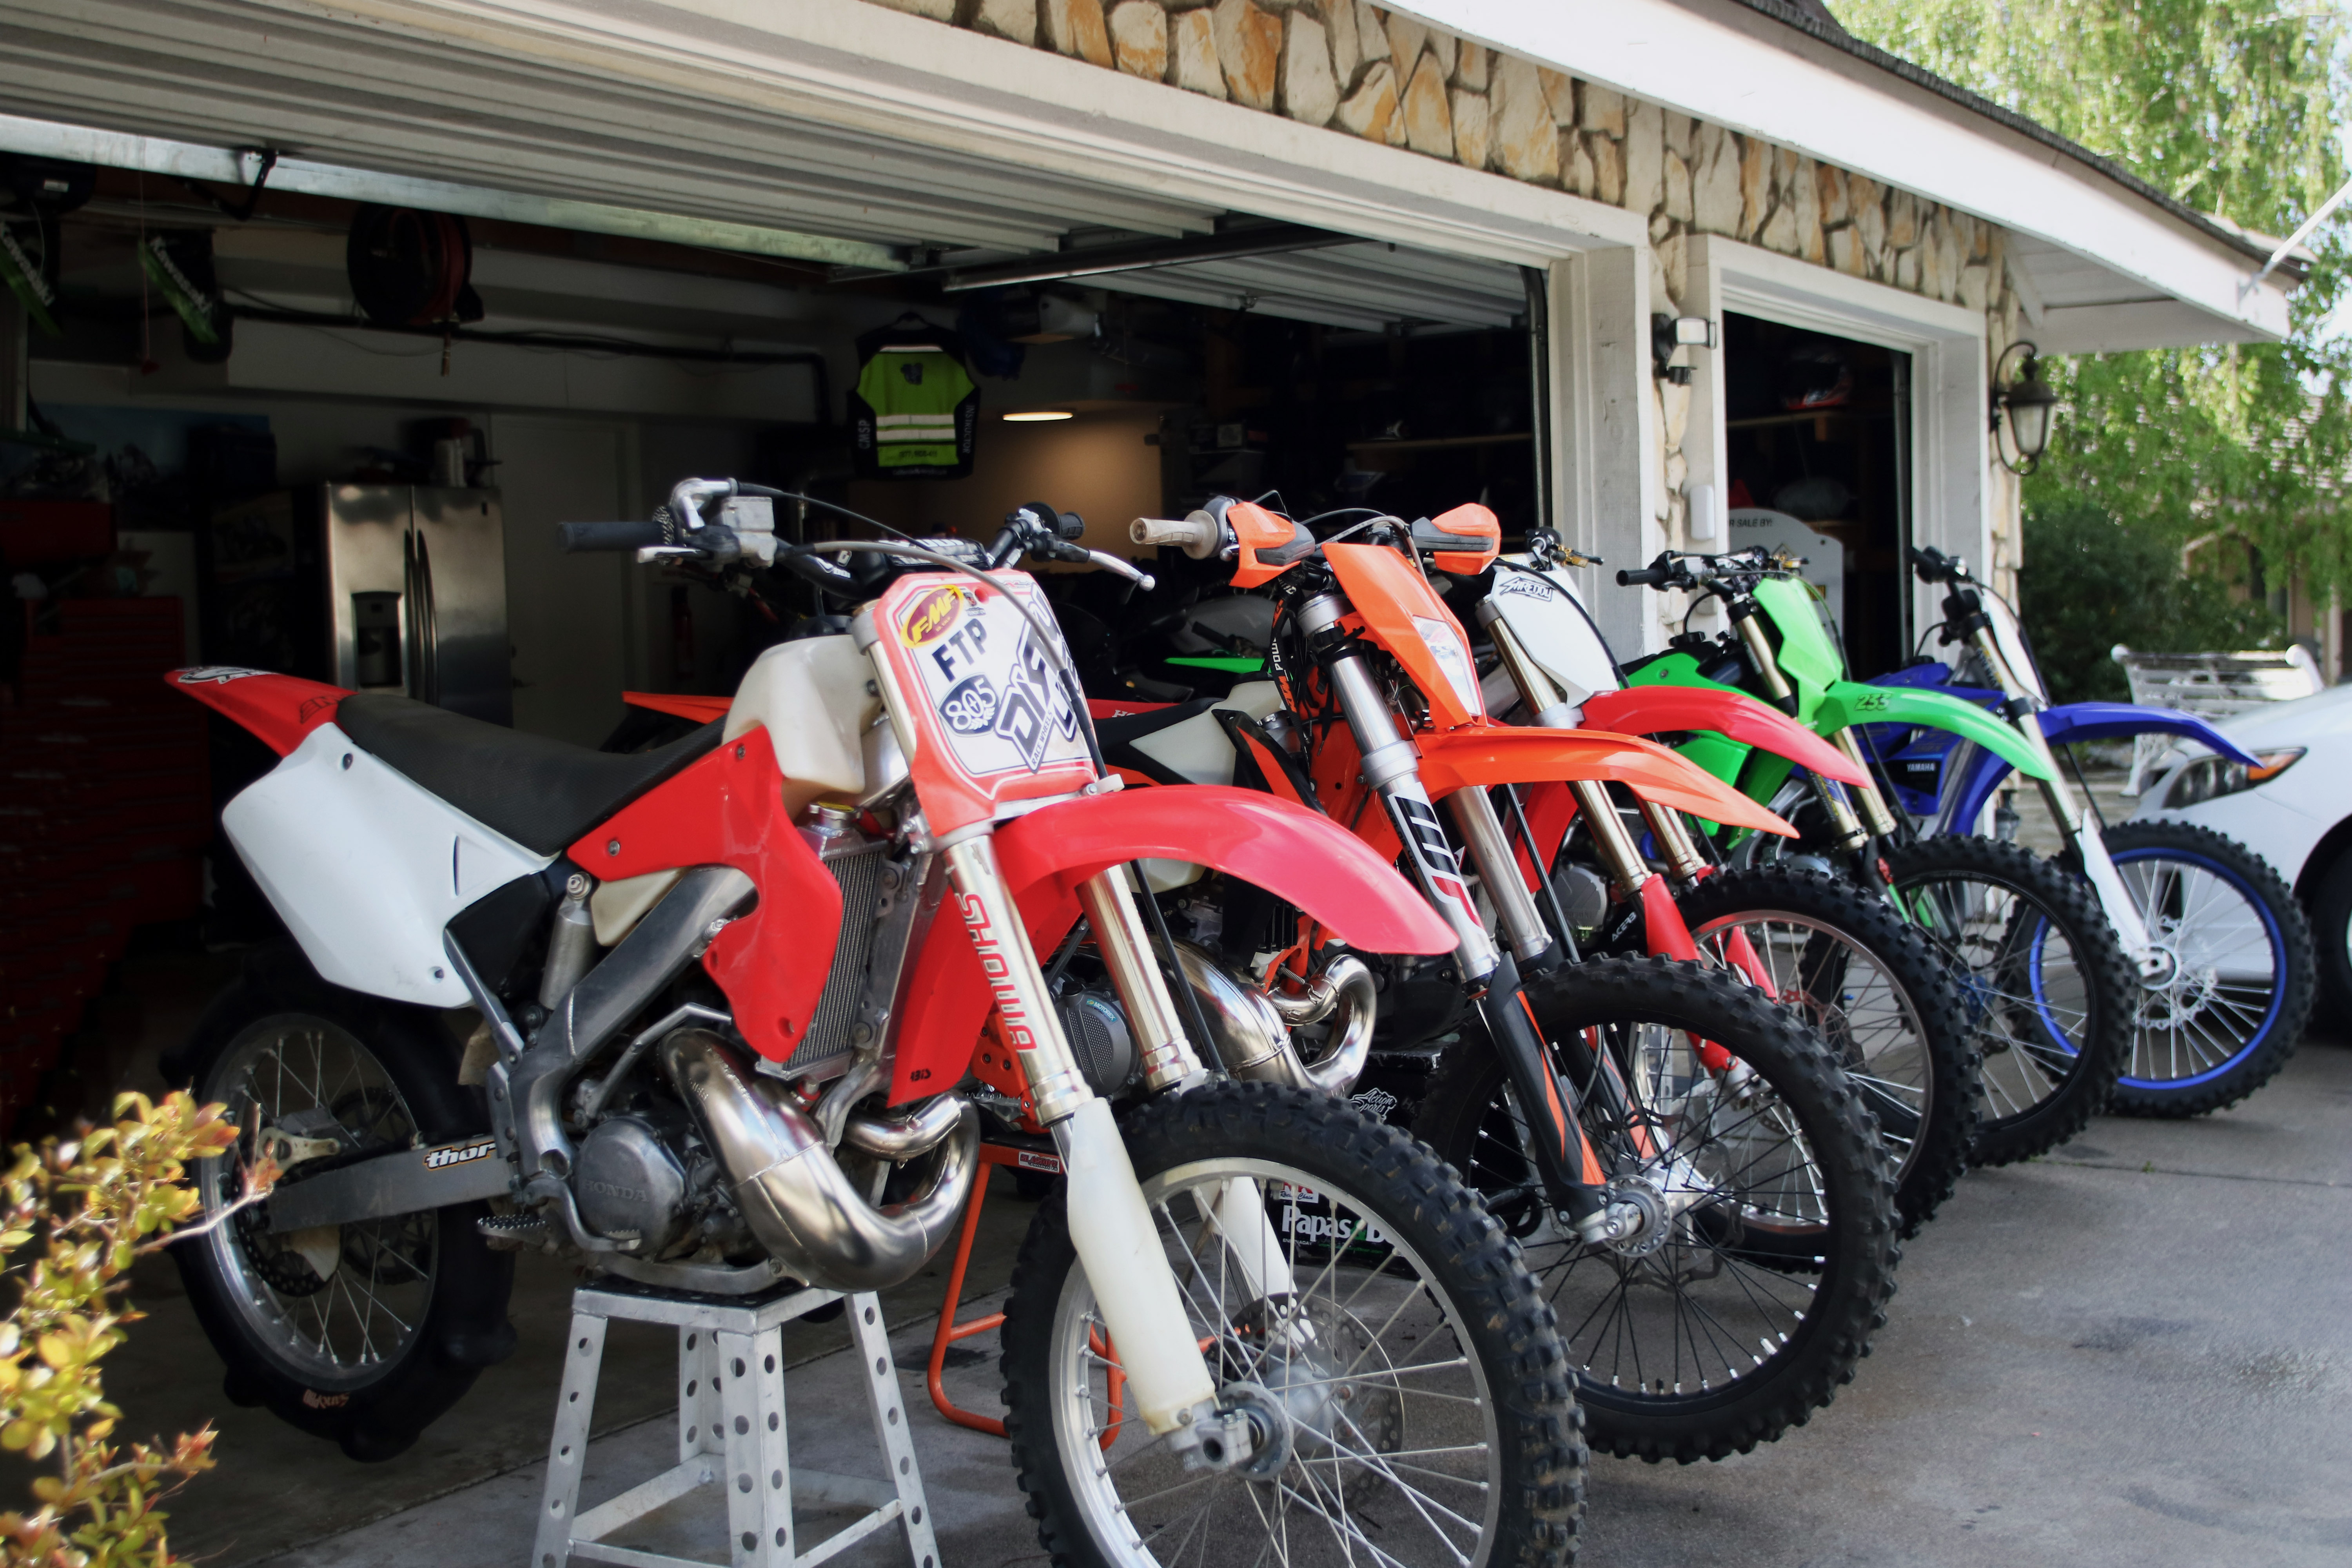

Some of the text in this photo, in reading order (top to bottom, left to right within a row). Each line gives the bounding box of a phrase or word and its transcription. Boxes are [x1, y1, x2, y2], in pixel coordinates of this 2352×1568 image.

[858, 419, 871, 449] CMSP
[962, 404, 975, 454] INSTRUCTOR
[1737, 519, 1758, 527] SALE
[1499, 577, 1553, 601] SHREDDY
[911, 588, 956, 645] FMF
[932, 618, 987, 683] FTP
[945, 678, 996, 730] 805
[1854, 693, 1892, 711] 233
[1031, 711, 1053, 766] RACE WHEELS
[1907, 763, 1935, 772] YAMAHA
[955, 893, 1037, 1053] SHOWA
[1093, 1001, 1116, 1021] MOTOREX
[1355, 1090, 1394, 1105] Action
[426, 1142, 496, 1169] thor
[1029, 1162, 1058, 1171] PRODUCTS
[581, 1178, 650, 1203] HONDA
[1282, 1205, 1352, 1242] Papas
